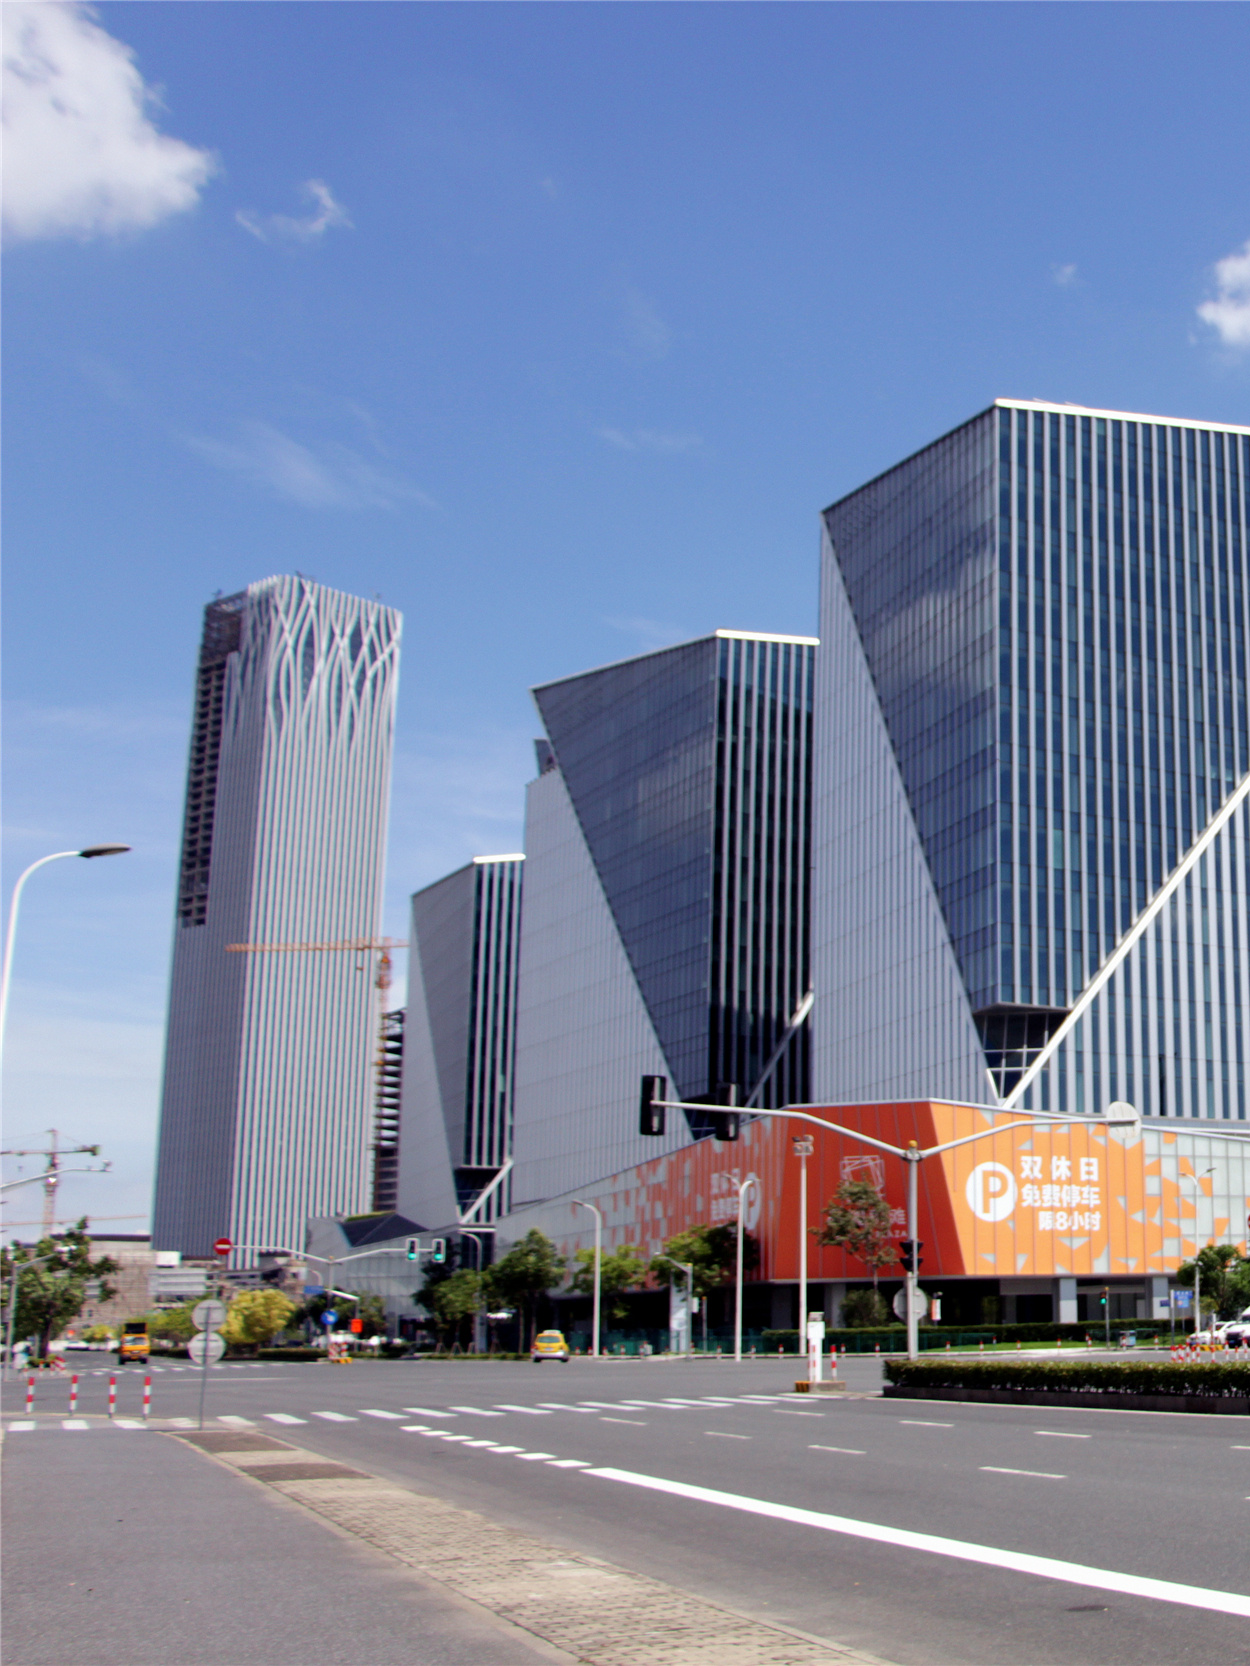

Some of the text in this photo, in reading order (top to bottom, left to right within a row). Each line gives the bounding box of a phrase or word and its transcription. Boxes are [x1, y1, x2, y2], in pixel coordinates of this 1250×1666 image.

[1020, 1155, 1099, 1181] 双休日
[1021, 1183, 1101, 1208] 免费停车
[1038, 1210, 1101, 1231] 限8小时
